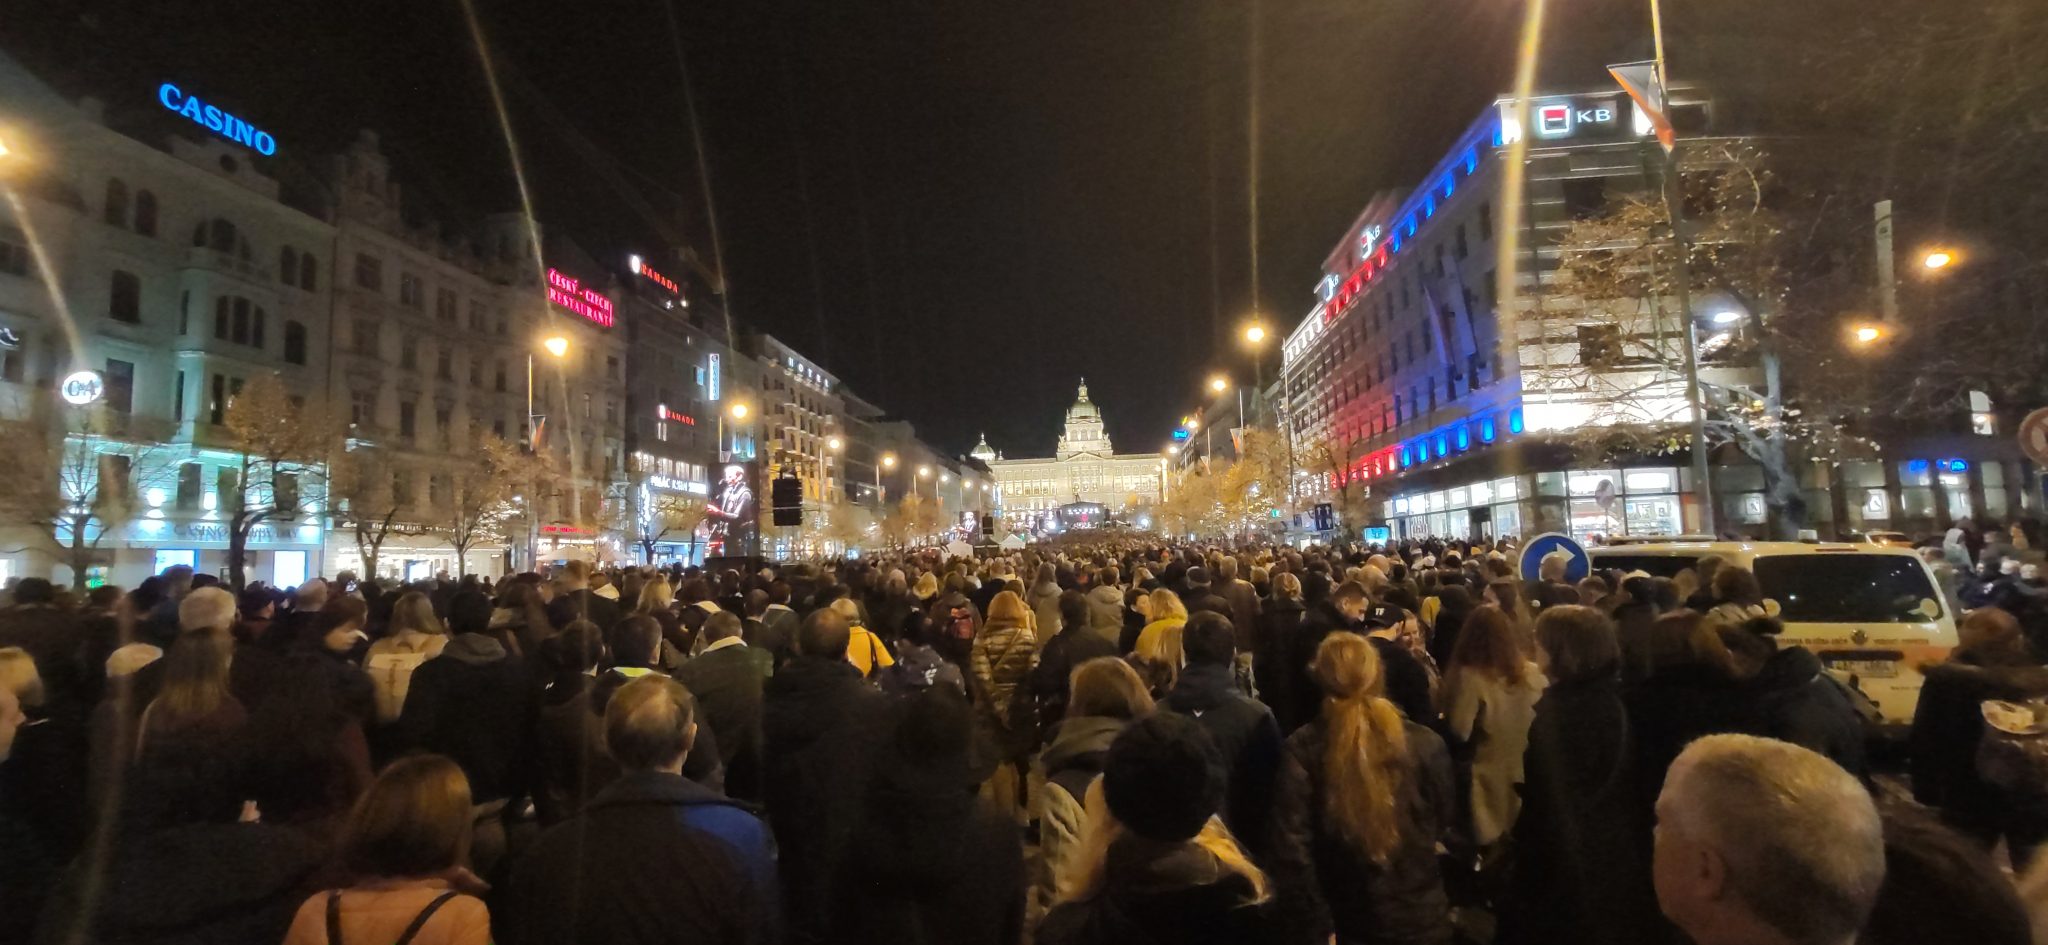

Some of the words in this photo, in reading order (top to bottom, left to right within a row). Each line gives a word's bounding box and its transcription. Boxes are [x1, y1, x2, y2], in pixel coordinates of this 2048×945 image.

[160, 83, 275, 156] CASINO
[1577, 109, 1611, 124] KB
[641, 264, 678, 294] RAMADA
[549, 287, 609, 327] RESTAURANT
[585, 290, 610, 311] CZECH
[788, 356, 829, 388] HOTEL
[666, 409, 695, 426] RAMADA
